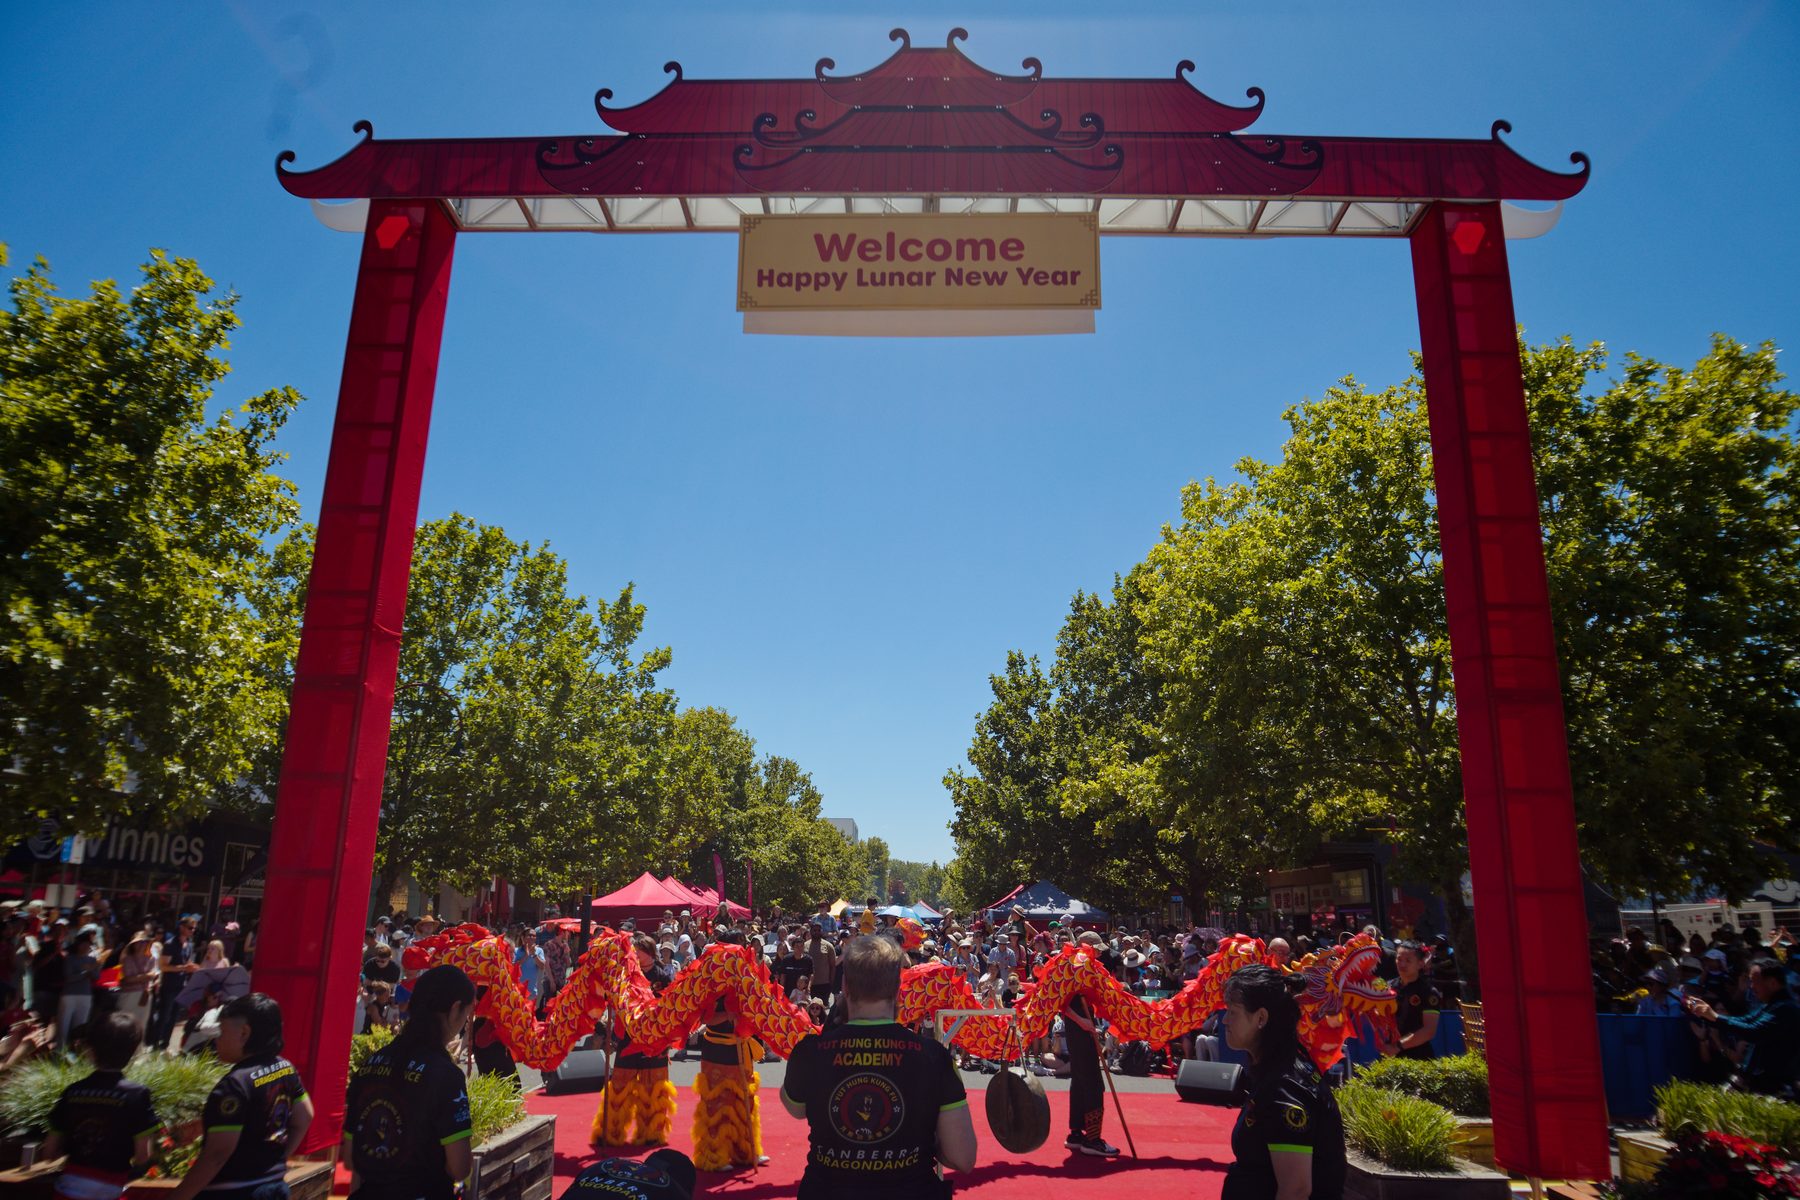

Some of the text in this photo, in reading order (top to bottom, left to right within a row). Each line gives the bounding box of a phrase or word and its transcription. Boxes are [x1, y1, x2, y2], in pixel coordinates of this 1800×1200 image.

[813, 231, 1026, 263] Welcome
[757, 266, 1081, 292] Happy Lunar New Year
[817, 1038, 922, 1051] YUT HUNG KUNG FU
[832, 1052, 904, 1067] ACADEMY
[834, 1076, 898, 1103] YUT HUNG KUNG FU
